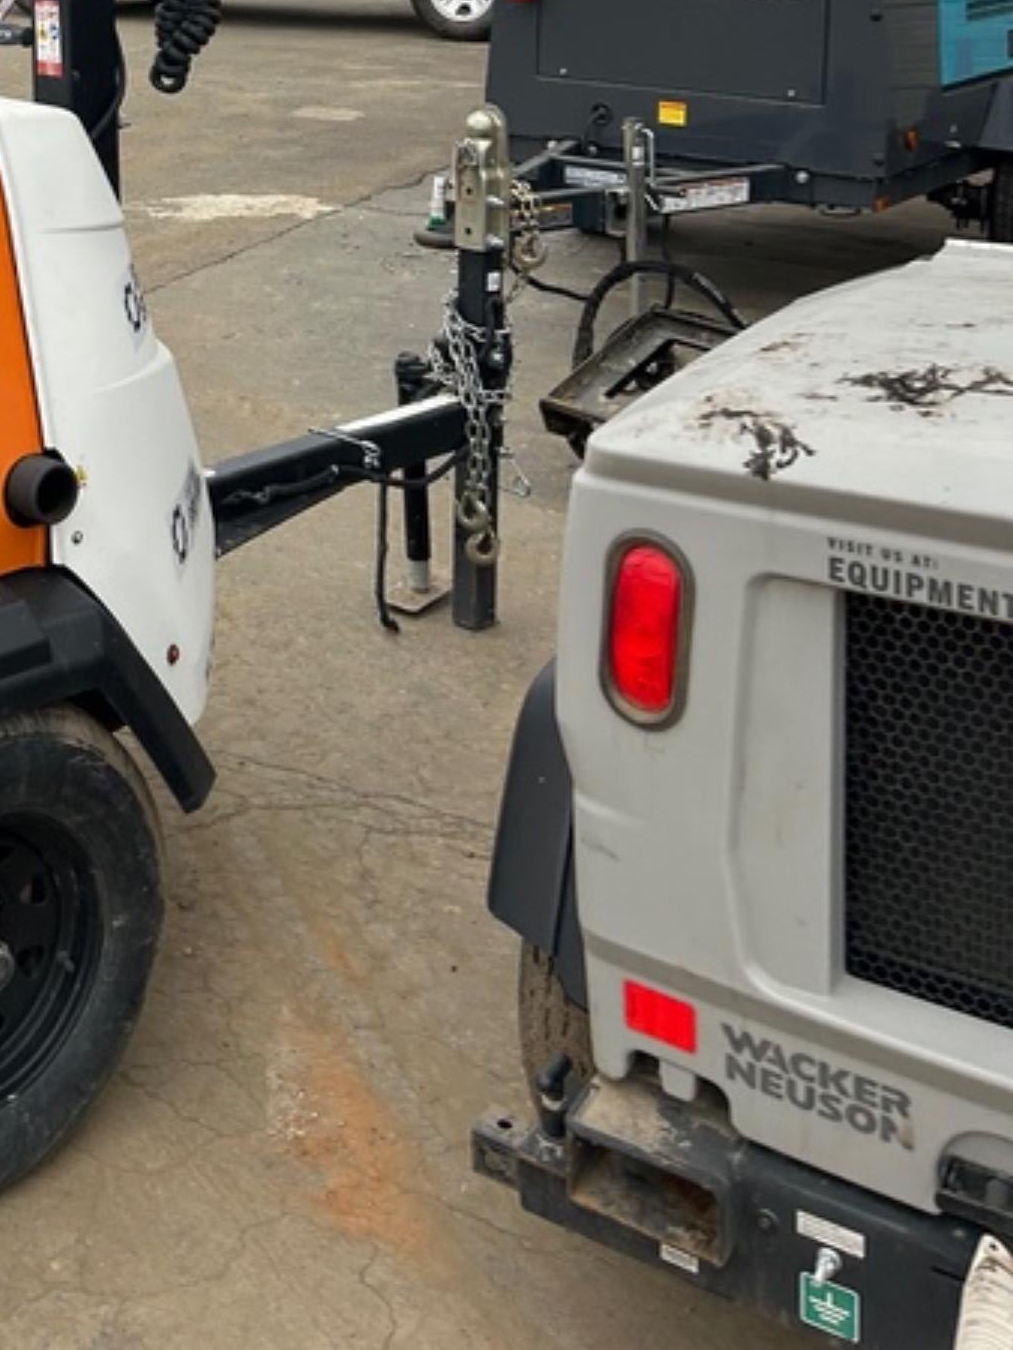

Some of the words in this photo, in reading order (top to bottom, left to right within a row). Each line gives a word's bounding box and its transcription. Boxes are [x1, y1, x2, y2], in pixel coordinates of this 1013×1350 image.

[827, 536, 873, 555] VISIT
[881, 548, 903, 562] US
[721, 1022, 911, 1119] WACKER
